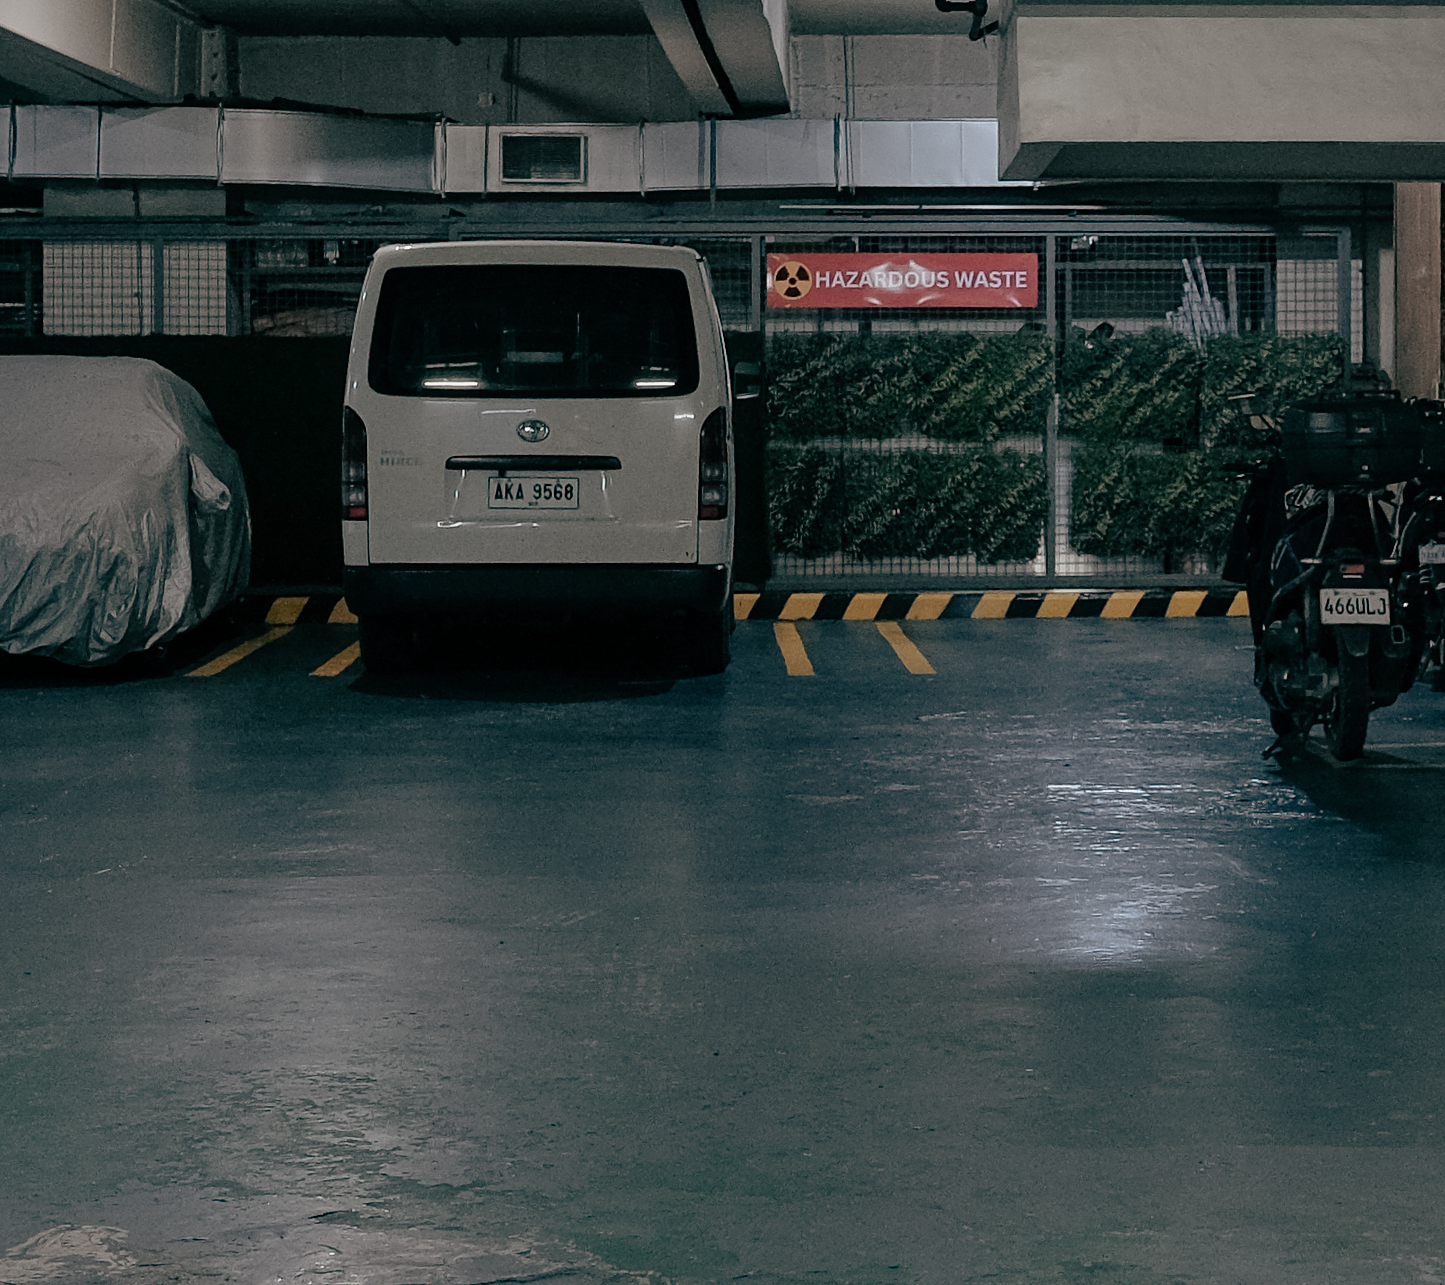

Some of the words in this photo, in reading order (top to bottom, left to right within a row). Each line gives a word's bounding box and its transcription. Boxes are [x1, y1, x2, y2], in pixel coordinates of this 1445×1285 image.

[815, 271, 949, 289] HAZARDOUS
[955, 271, 1028, 289] WASTE
[494, 482, 524, 501] AKA
[532, 483, 574, 501] 9568
[1324, 597, 1387, 615] 466ULJ
